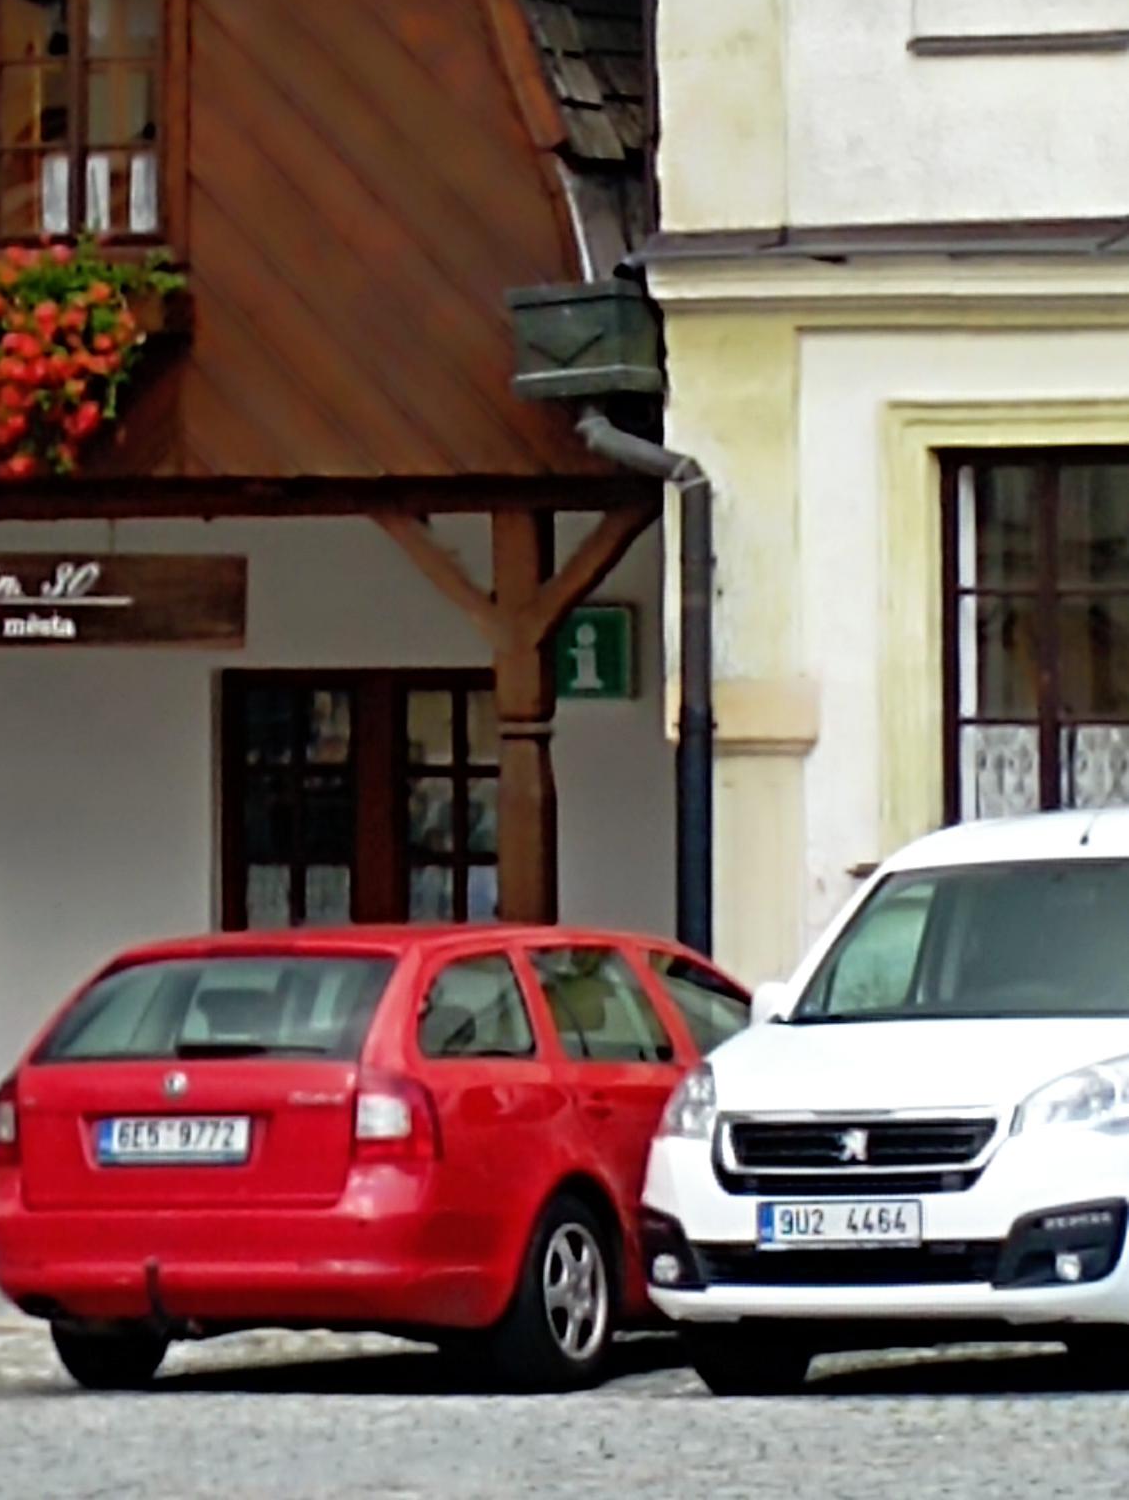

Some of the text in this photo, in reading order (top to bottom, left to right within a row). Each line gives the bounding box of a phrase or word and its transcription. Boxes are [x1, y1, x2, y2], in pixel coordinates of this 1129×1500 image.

[117, 1120, 237, 1149] 6E5 9772
[779, 1205, 907, 1236] 9U2 4464
